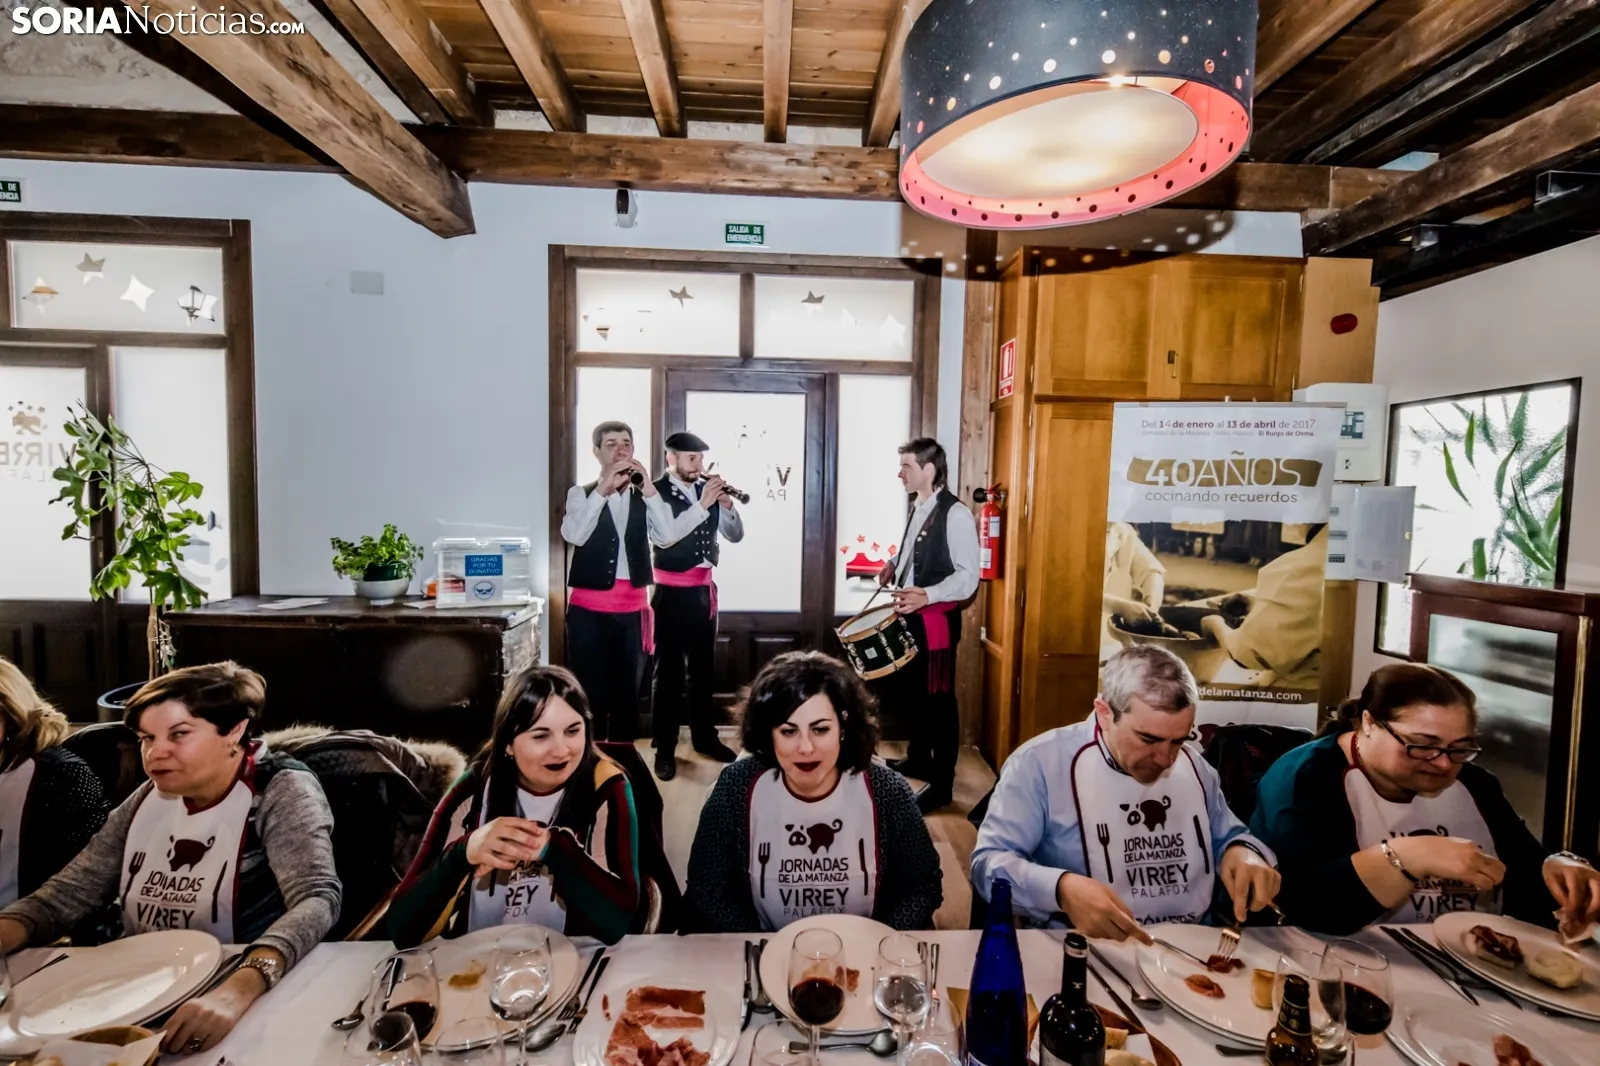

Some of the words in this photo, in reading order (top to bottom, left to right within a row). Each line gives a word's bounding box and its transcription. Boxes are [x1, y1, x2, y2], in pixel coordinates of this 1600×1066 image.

[728, 225, 749, 233] SALIDA
[753, 226, 761, 234] DE
[1141, 420, 1156, 428] Del
[1159, 420, 1171, 428] 14
[1172, 420, 1184, 428] de
[1216, 420, 1225, 428] al
[1227, 420, 1237, 428] 13
[1239, 420, 1251, 428] de
[1254, 420, 1276, 428] abril
[1278, 420, 1290, 428] de
[1292, 419, 1316, 428] 2017
[1145, 489, 1220, 502] cocinando
[1224, 490, 1298, 503] recuerdos
[1199, 686, 1302, 700] delamatanza.com
[1123, 833, 1184, 852] JORNADAS
[1146, 848, 1187, 860] MATANZA
[778, 857, 849, 873] JORNADAS
[805, 872, 849, 882] MATANZA
[1126, 863, 1189, 887] VIRREY
[779, 887, 849, 907] VIRREY
[1131, 884, 1190, 898] PALAFOX
